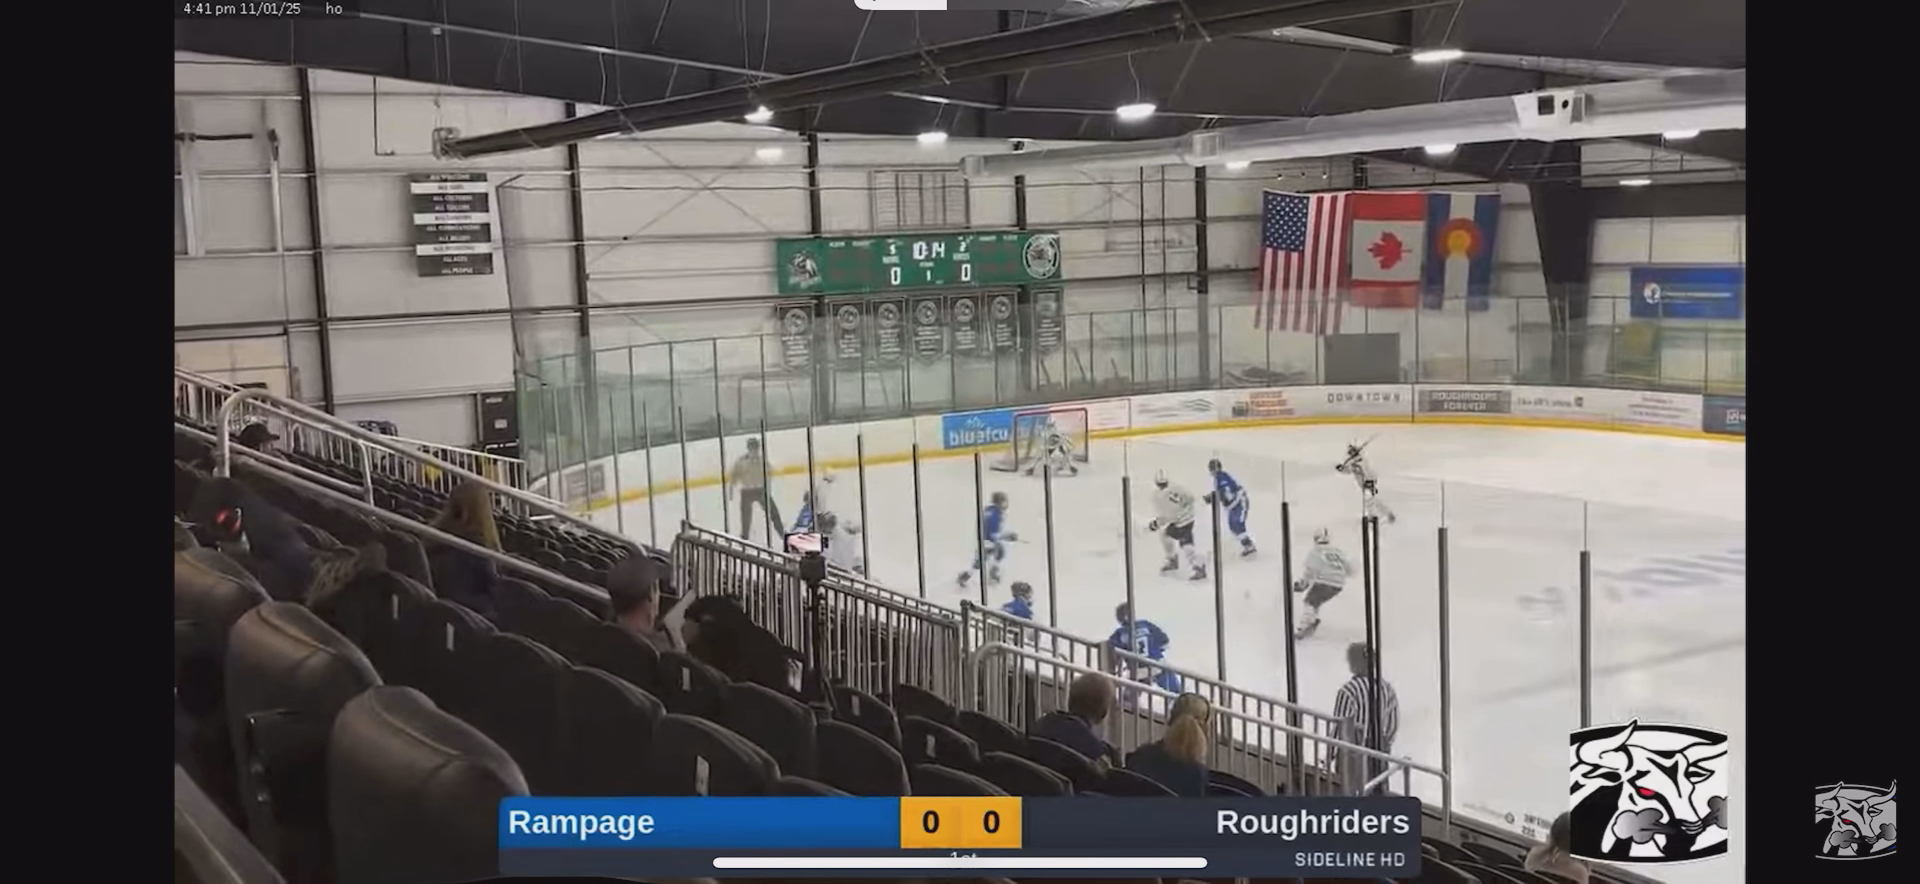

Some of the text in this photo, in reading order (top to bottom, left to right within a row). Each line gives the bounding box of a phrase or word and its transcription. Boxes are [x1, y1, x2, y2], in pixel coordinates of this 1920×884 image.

[890, 266, 901, 286] 0
[926, 269, 932, 282] 1
[961, 263, 971, 282] 0
[950, 427, 1008, 446] bluefcu
